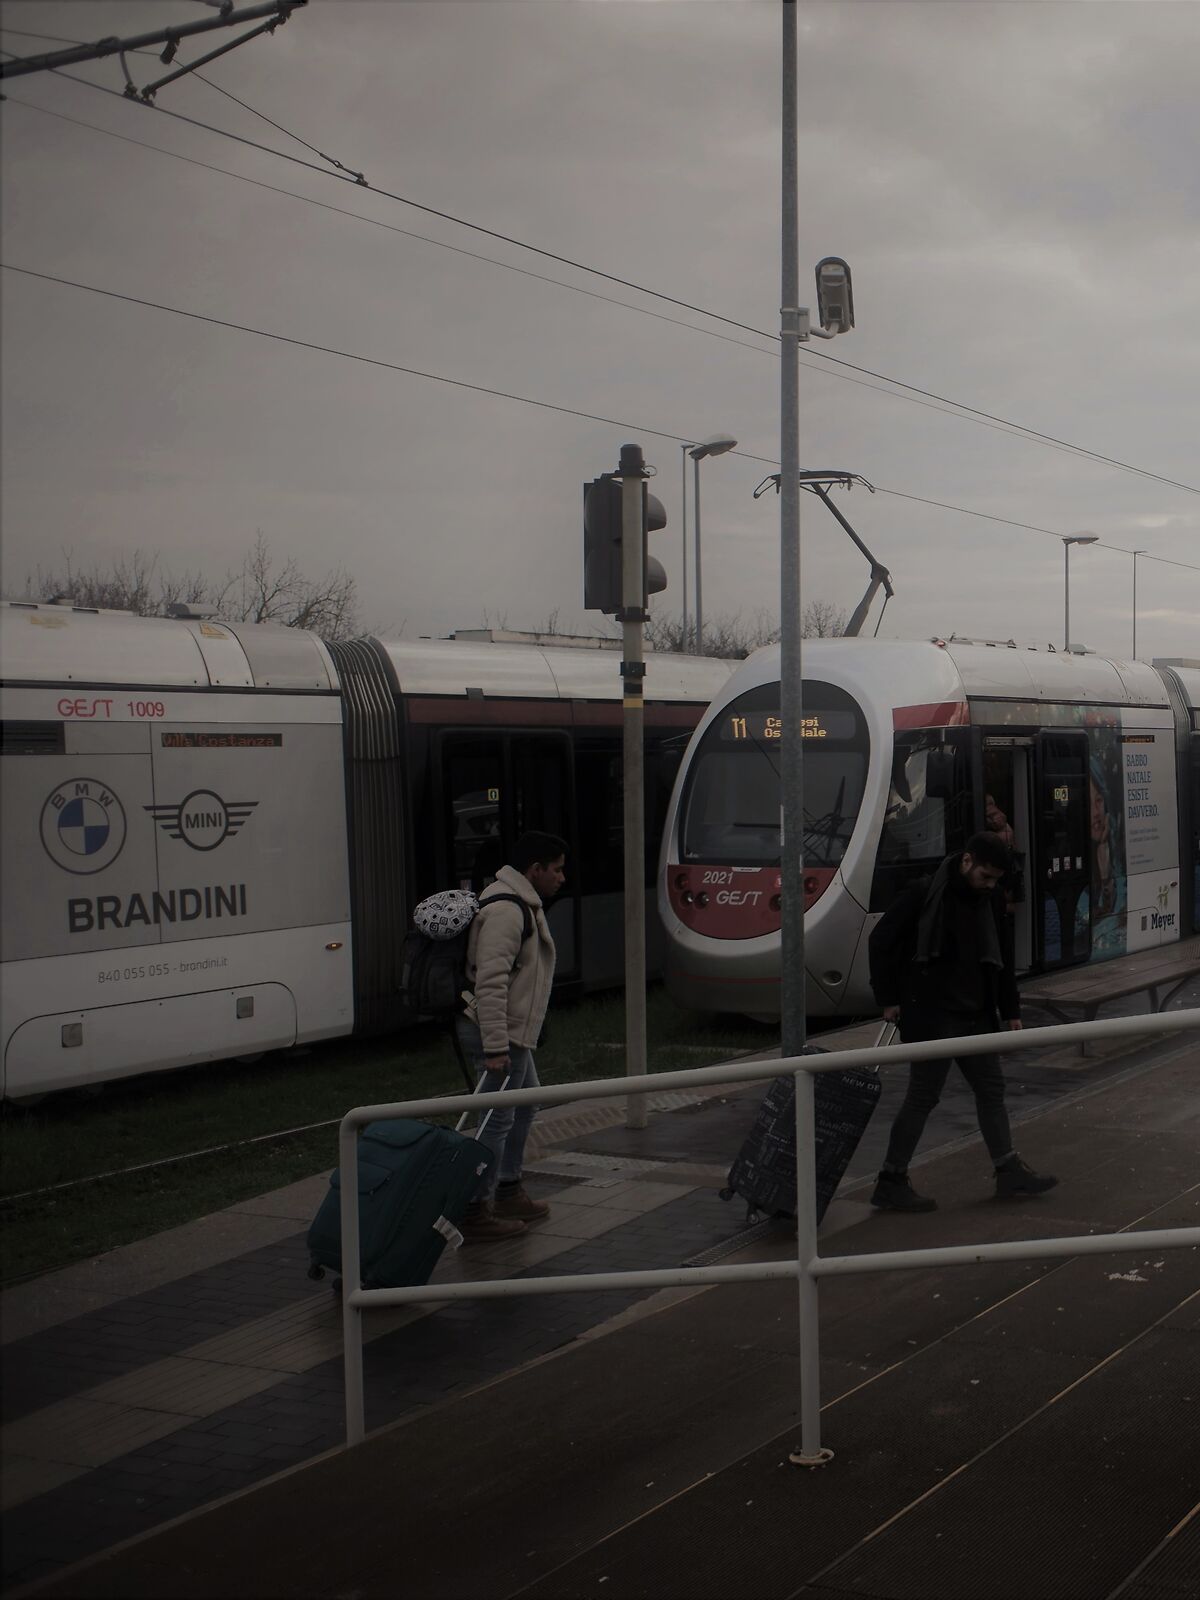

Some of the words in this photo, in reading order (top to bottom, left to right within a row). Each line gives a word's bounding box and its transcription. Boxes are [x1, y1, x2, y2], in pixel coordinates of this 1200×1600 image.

[57, 699, 113, 718] GEST
[127, 701, 165, 717] 1009
[731, 717, 747, 739] T1
[764, 727, 828, 739] Osdale
[1126, 754, 1148, 767] BABBO
[1127, 771, 1152, 784] NATALE
[51, 783, 114, 810] BMW
[1128, 788, 1149, 801] ESISTE
[185, 812, 222, 829] MINI
[702, 870, 734, 885] 2021
[716, 890, 763, 906] GEST
[68, 884, 247, 933] BRANDINI
[1151, 913, 1176, 931] Meyer
[97, 970, 121, 984] 840
[123, 966, 146, 980] 055
[148, 963, 170, 977] 055
[179, 958, 228, 973] brandini.it
